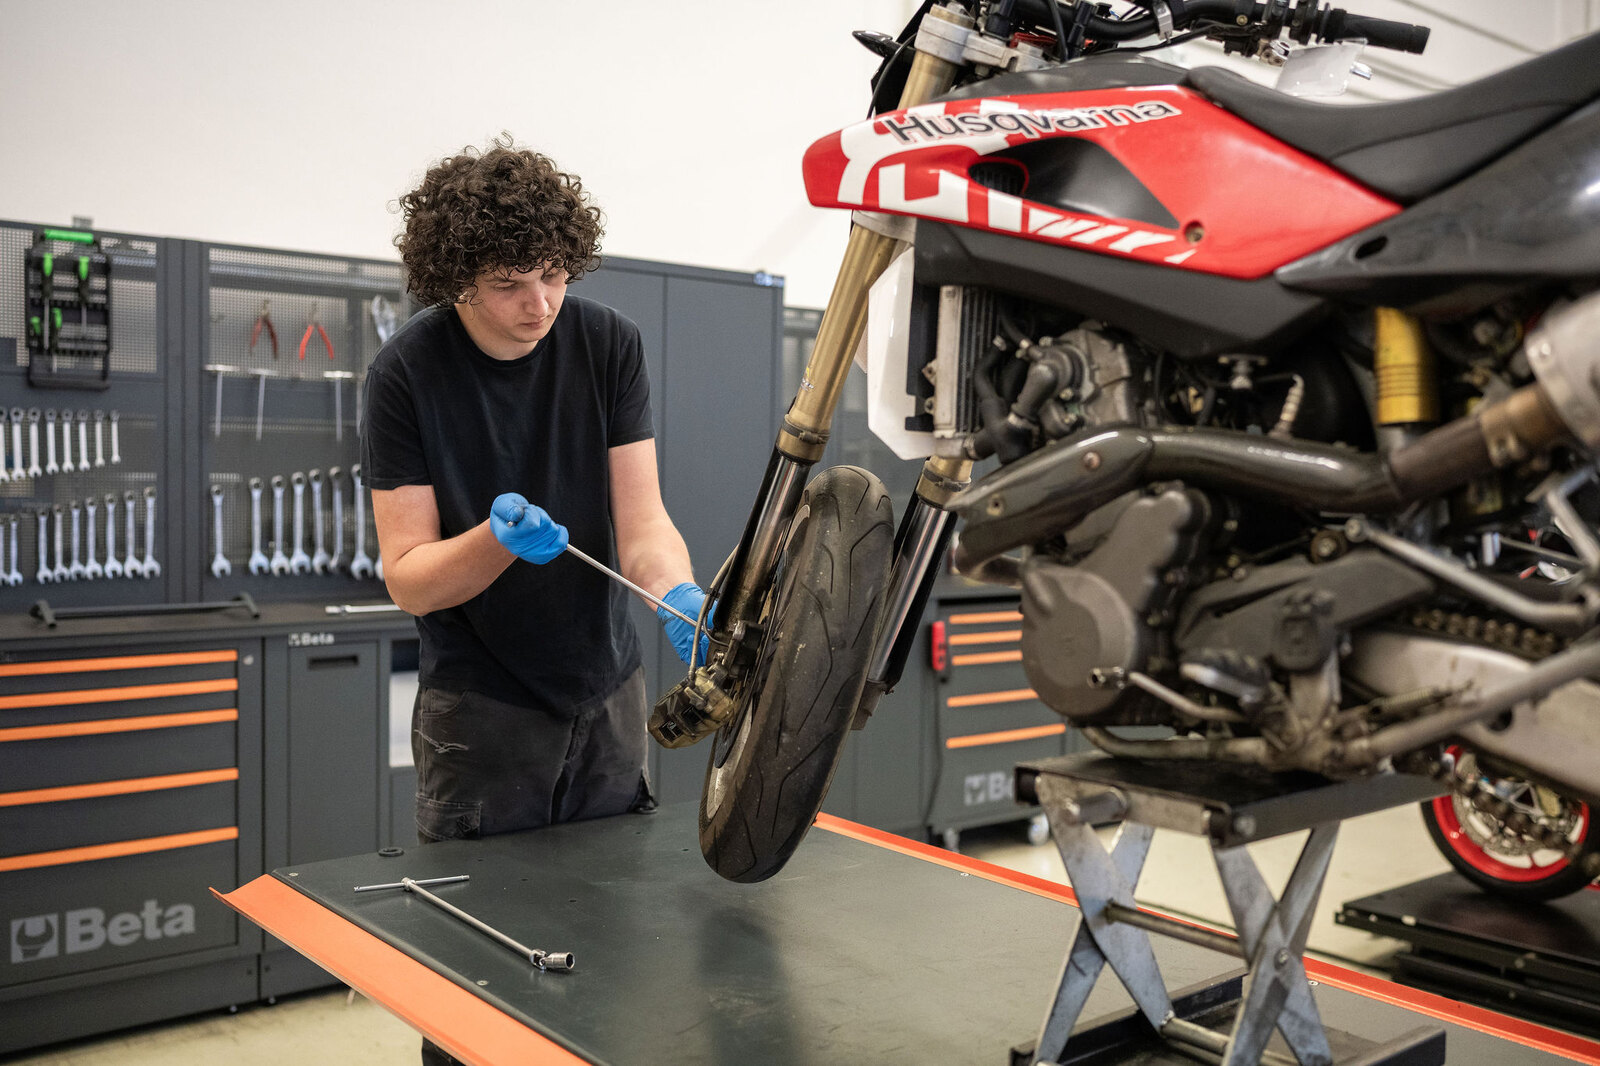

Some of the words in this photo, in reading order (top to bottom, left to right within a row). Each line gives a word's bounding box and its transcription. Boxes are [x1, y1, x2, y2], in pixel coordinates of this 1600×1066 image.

[883, 101, 1179, 142] Husqvarna
[301, 632, 334, 646] Beta
[65, 900, 196, 954] Beta
